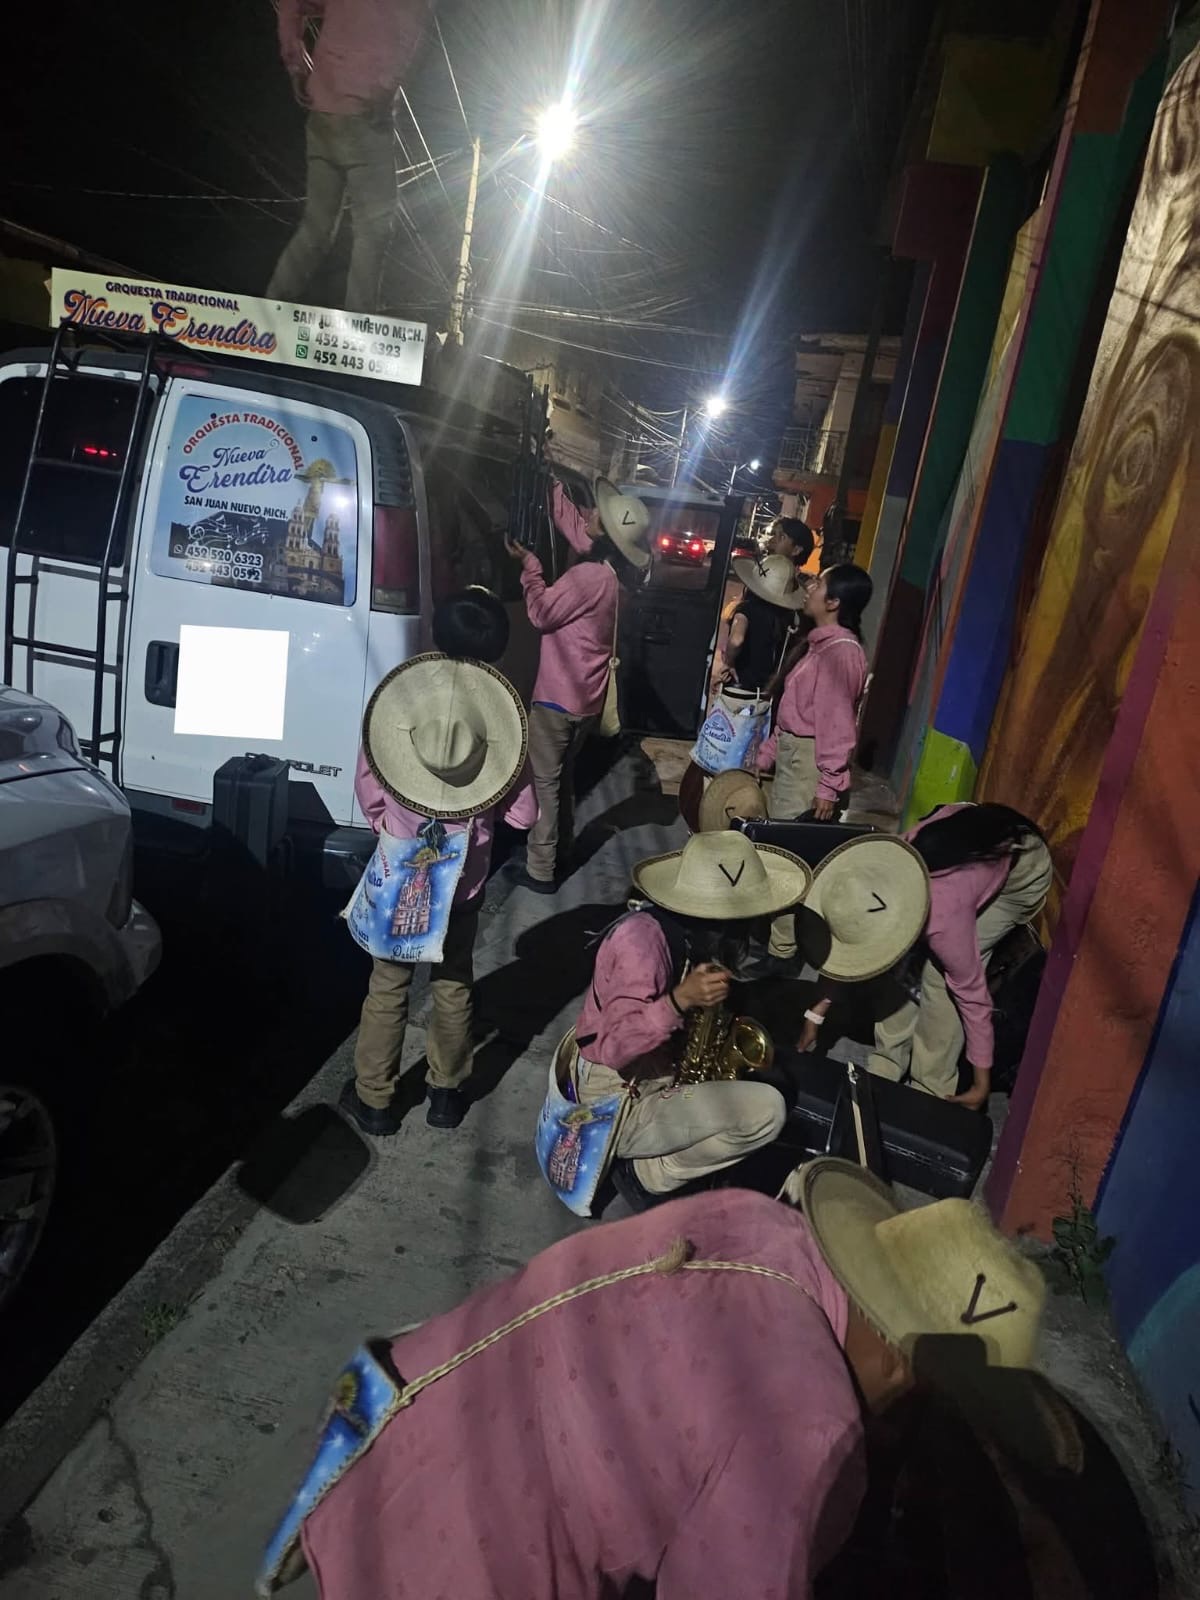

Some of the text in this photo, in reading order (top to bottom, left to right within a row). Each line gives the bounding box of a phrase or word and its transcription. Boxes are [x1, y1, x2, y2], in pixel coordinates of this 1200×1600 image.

[105, 281, 240, 312] ORQUESTA TRADICIONAL
[59, 289, 277, 354] Nueva Erendira
[293, 310, 316, 325] SAN
[351, 318, 389, 337] NUEVO
[315, 332, 339, 348] 452
[313, 350, 337, 366] 452
[341, 355, 364, 370] 443
[183, 413, 304, 470] ORQUESTA TRADICIONAL
[212, 446, 266, 468] Nueva
[179, 463, 292, 493] Erendira
[184, 495, 289, 521] SAN JUAN NUEVO MICH.
[186, 545, 263, 567] 452 520 6323
